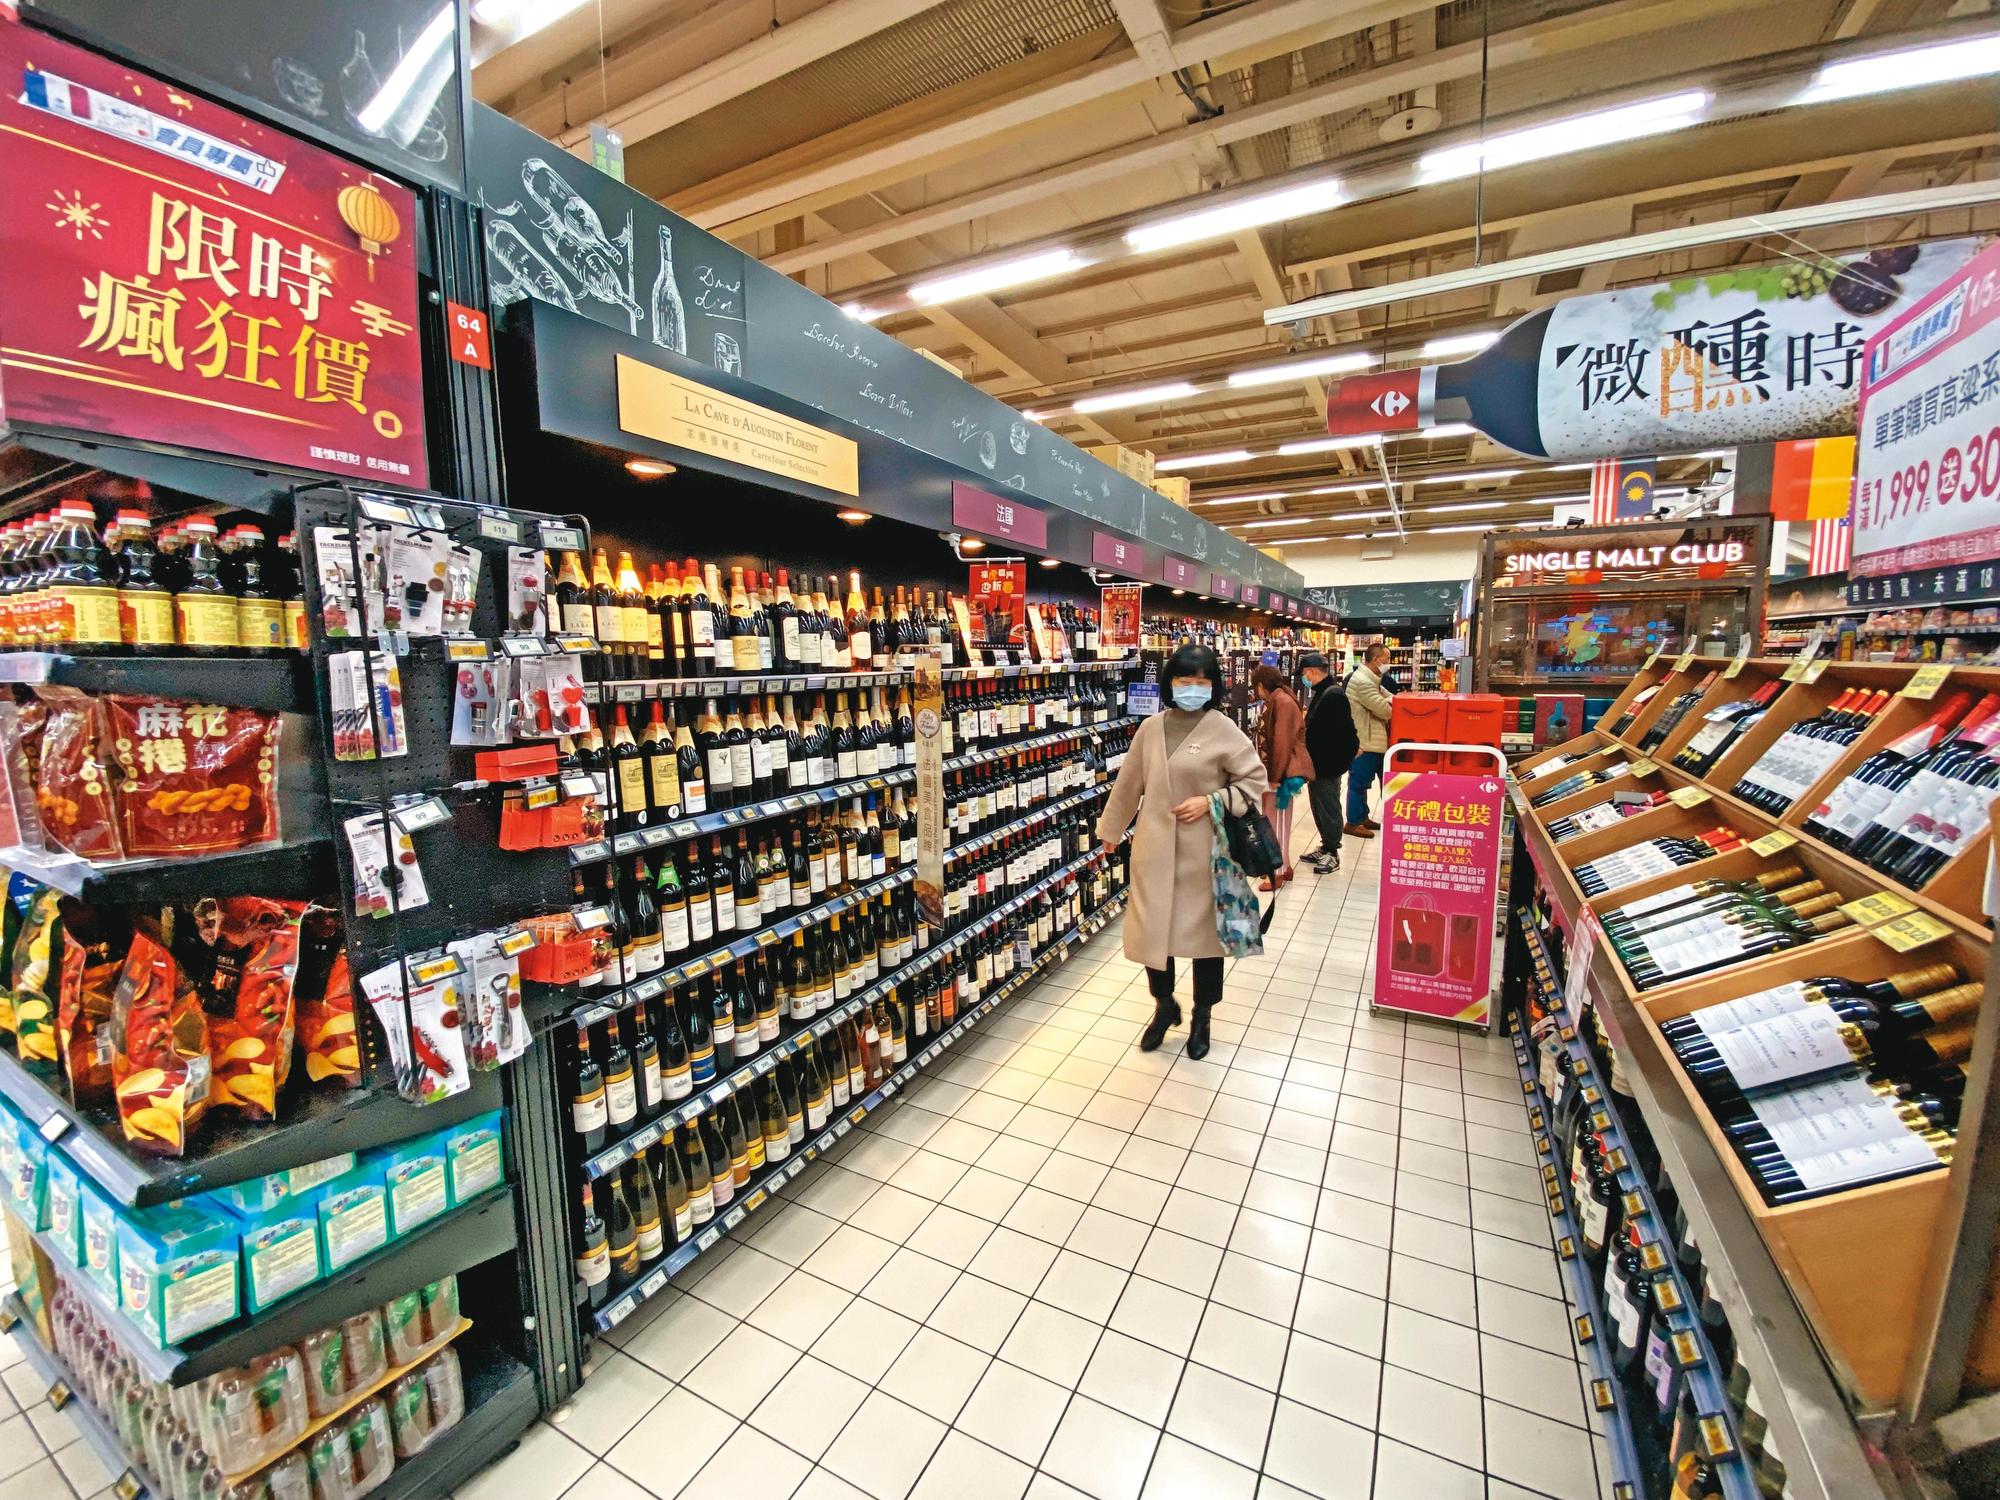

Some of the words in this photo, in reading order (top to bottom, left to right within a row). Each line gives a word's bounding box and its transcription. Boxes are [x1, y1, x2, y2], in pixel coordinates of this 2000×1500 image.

[154, 126, 255, 177] 會員專屬
[146, 191, 334, 321] 限時
[456, 313, 482, 334] 64
[77, 270, 372, 416] 瘋狂價
[463, 342, 479, 359] A
[310, 446, 361, 466] 謹慎理財
[366, 456, 410, 476] 信用無價
[1873, 460, 1931, 530] 1,999
[996, 503, 1014, 526] 法國
[553, 535, 568, 544] 149
[1505, 550, 1591, 573] SINGLE
[1596, 546, 1667, 569] MALT
[1671, 542, 1744, 564] CLUB
[136, 703, 229, 738] 麻花
[415, 811, 427, 821] 99
[1392, 798, 1492, 826] 好禮包裝
